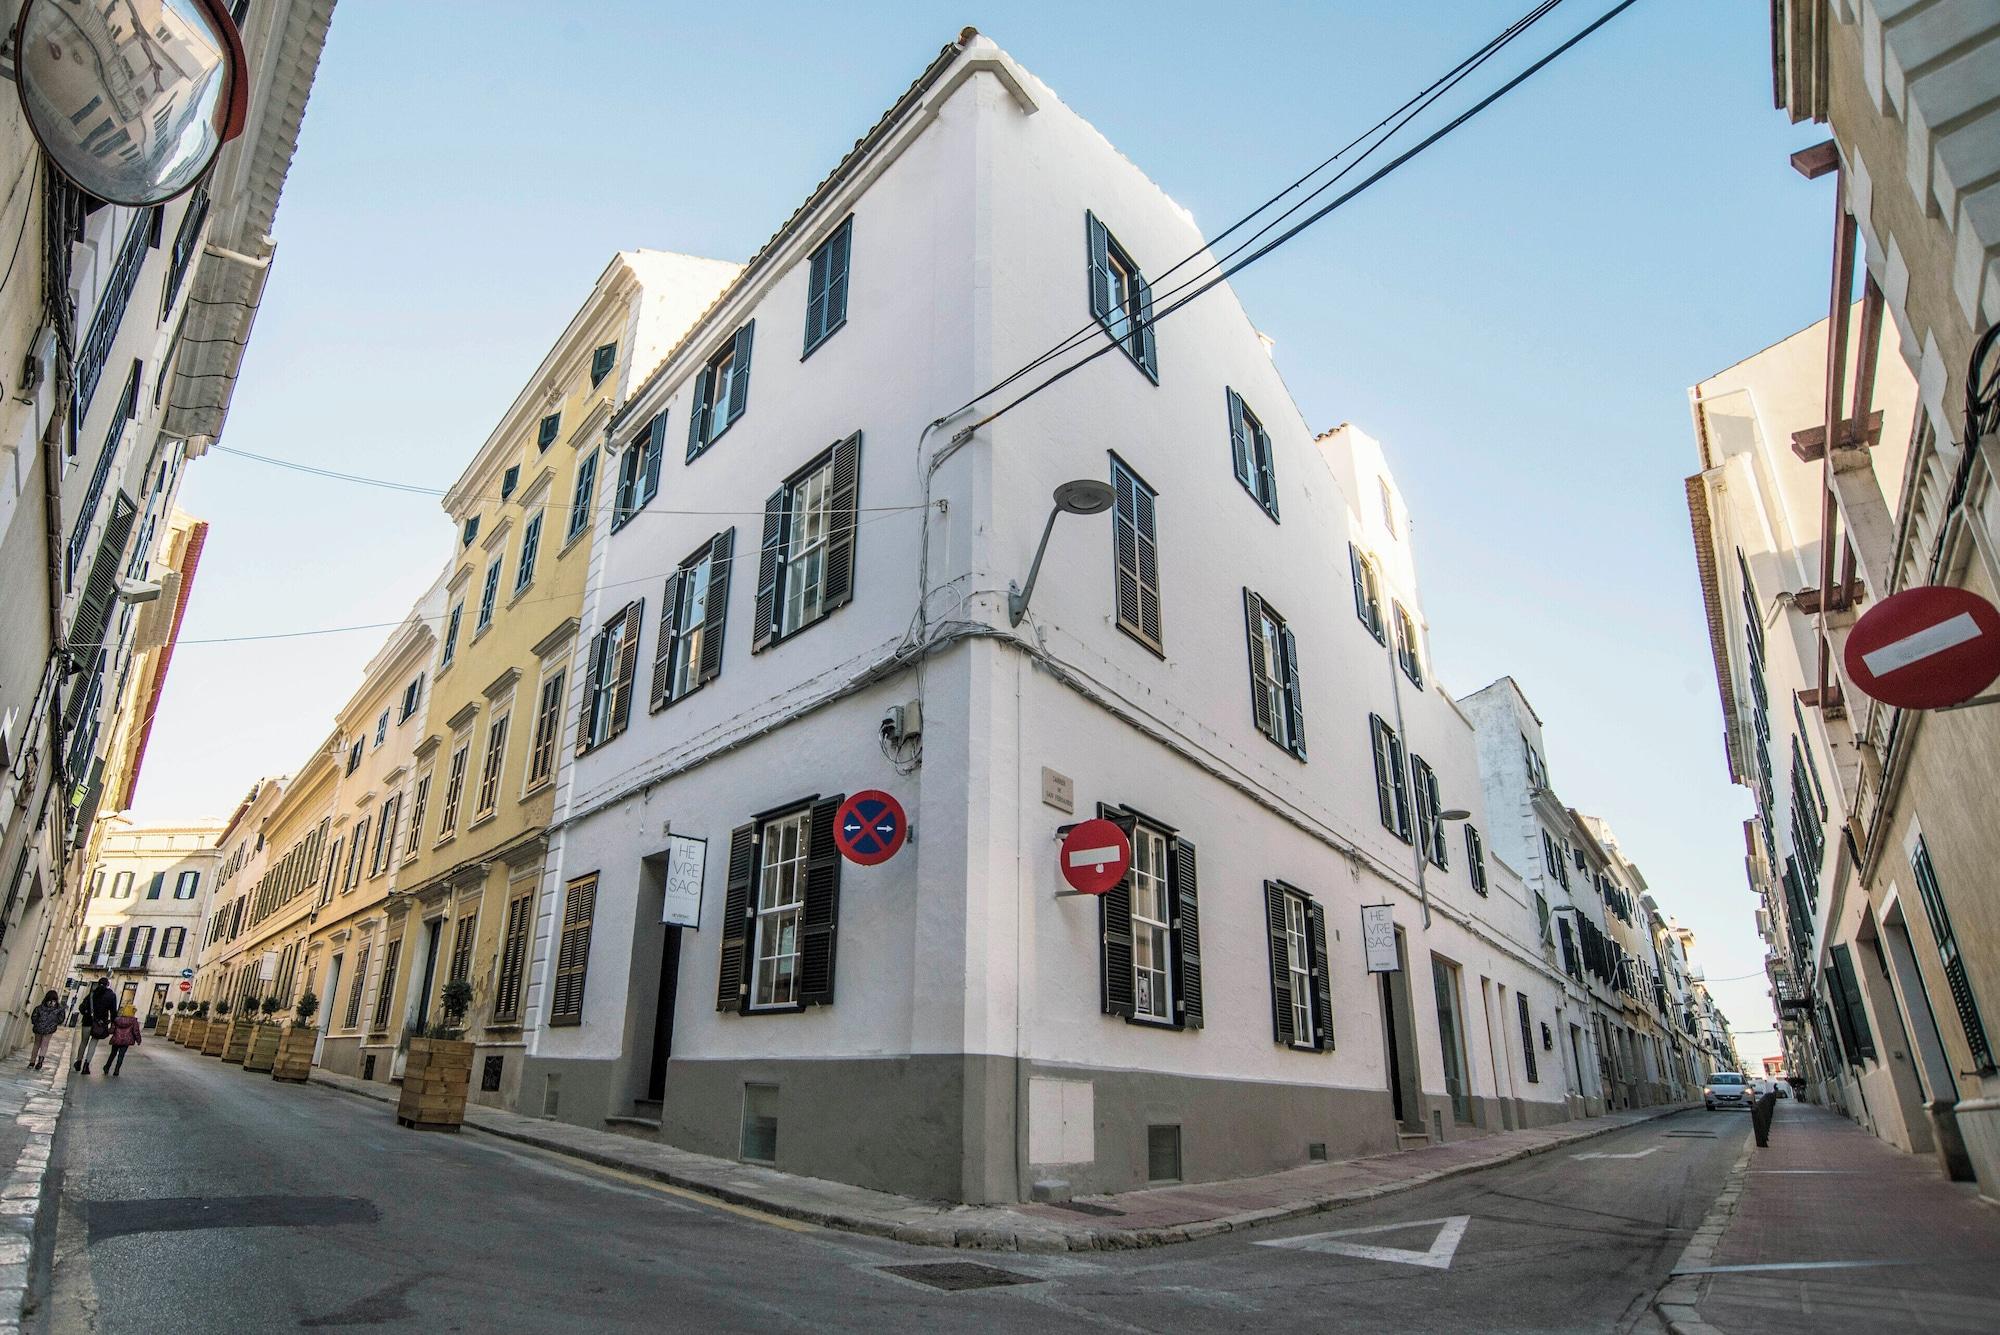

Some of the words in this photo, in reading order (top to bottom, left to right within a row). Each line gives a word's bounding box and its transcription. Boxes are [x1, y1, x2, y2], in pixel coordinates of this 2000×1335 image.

[679, 844, 696, 860] HE
[673, 860, 700, 878] VRE
[668, 877, 699, 896] SAC
[1370, 910, 1384, 921] HE
[1368, 923, 1391, 934] VRE
[1367, 936, 1393, 949] SAC
